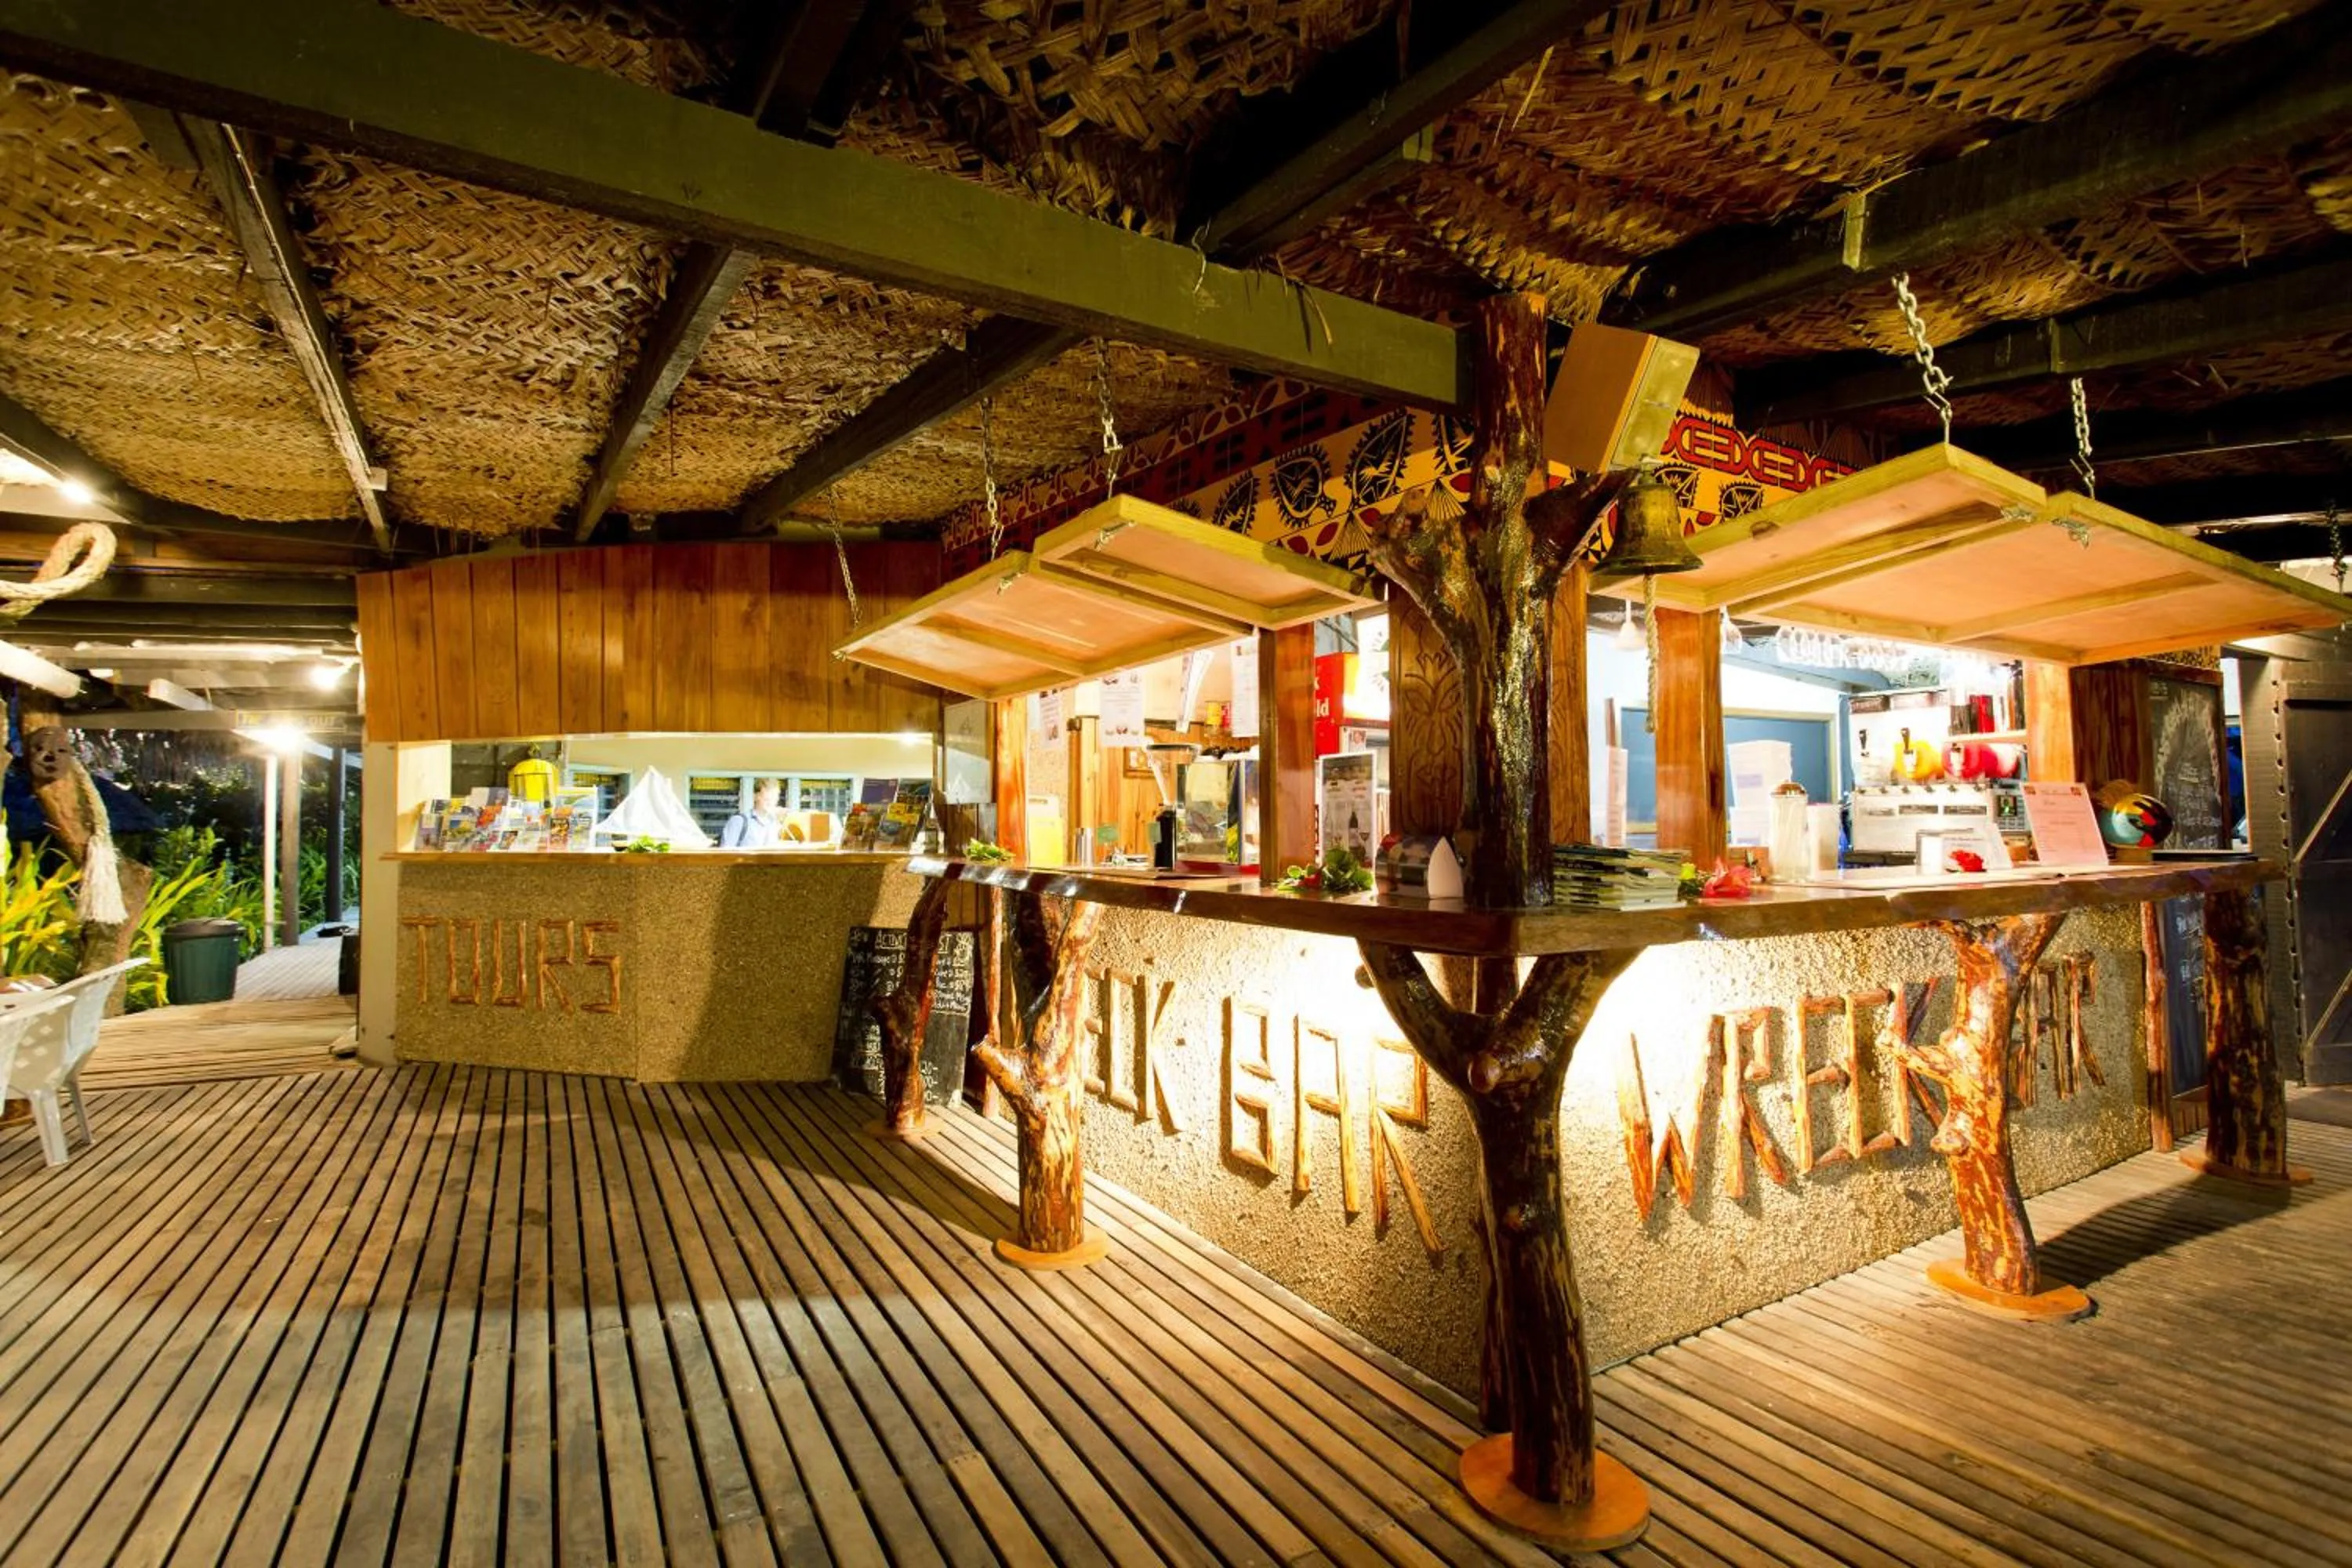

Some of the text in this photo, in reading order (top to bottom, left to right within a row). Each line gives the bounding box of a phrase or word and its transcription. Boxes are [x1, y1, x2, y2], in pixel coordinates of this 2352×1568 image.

[401, 915, 622, 1015] TOURS
[1080, 963, 1448, 1254] ECK BAR
[1617, 976, 1946, 1223] WRECK
